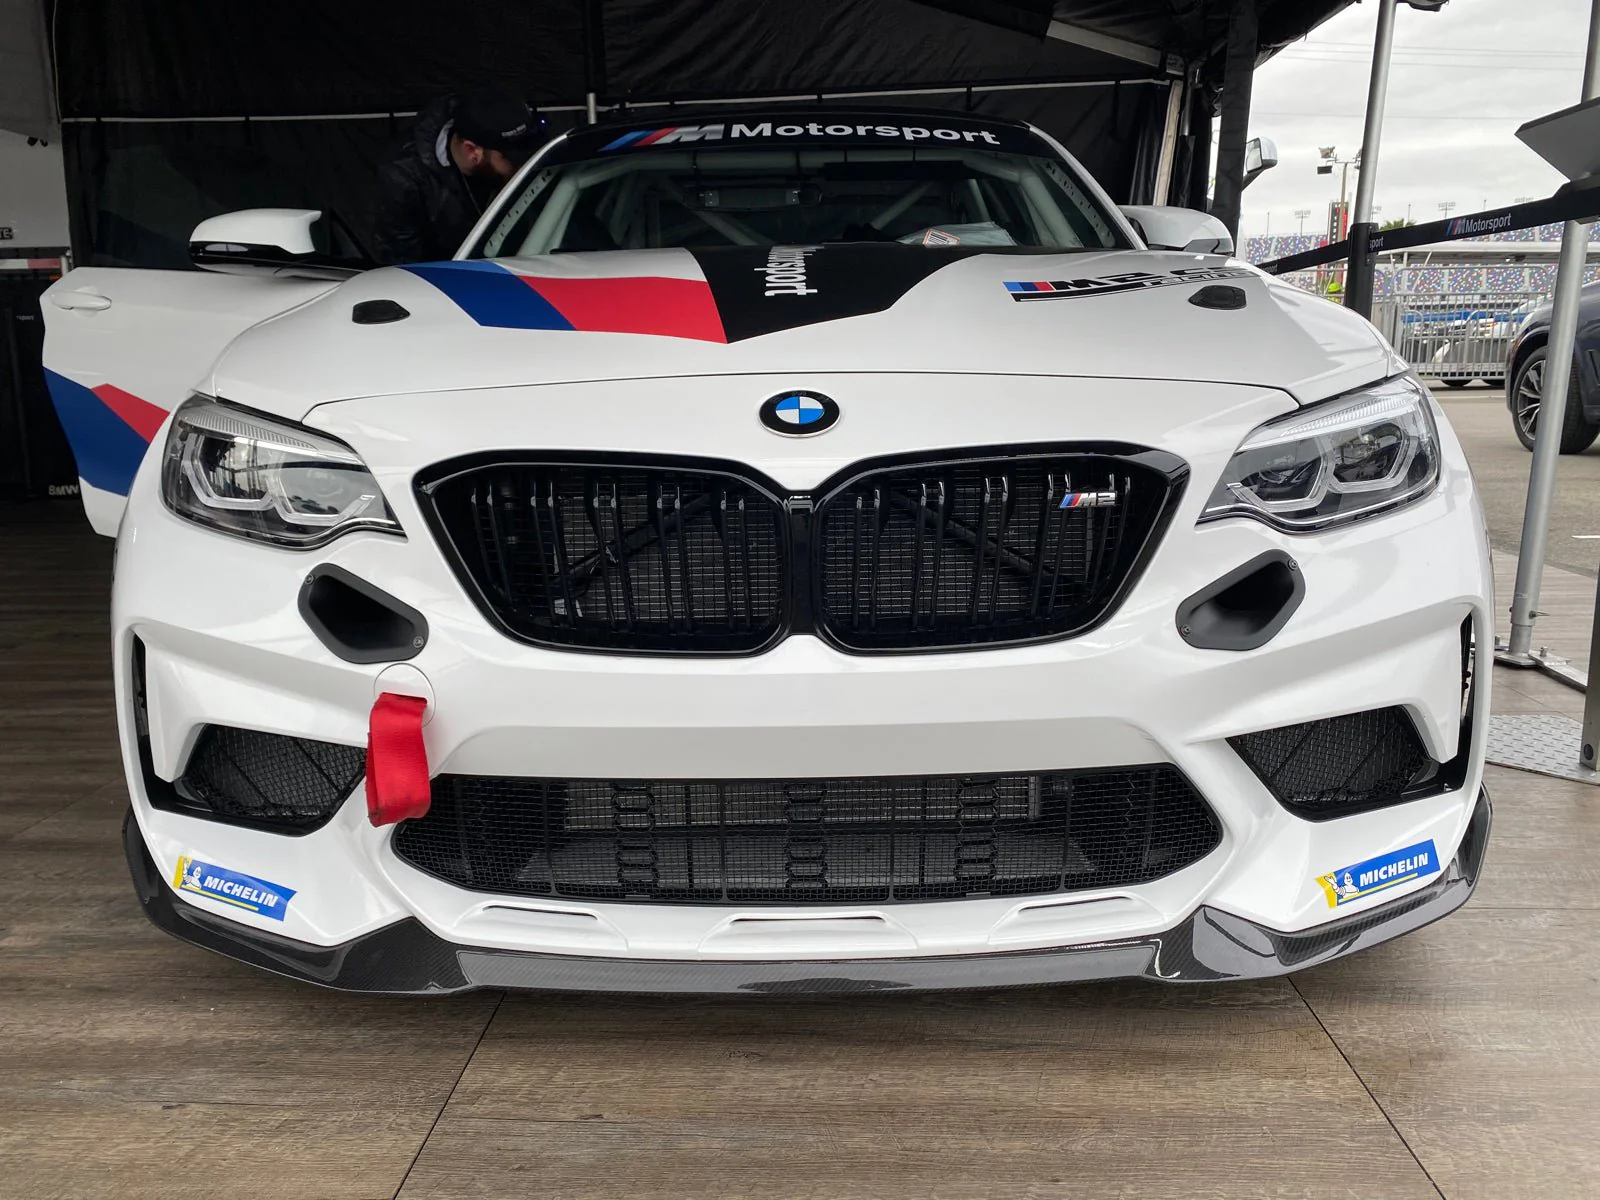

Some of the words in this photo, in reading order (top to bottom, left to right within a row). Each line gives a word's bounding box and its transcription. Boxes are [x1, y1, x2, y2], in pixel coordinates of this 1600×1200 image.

[730, 122, 1001, 145] Motorsport
[1465, 212, 1512, 233] Motorsport
[1049, 272, 1168, 291] M2
[48, 484, 79, 496] BMW
[1077, 492, 1116, 507] M2
[1359, 852, 1429, 887] MICHELIN
[202, 875, 279, 908] MICHELIN
